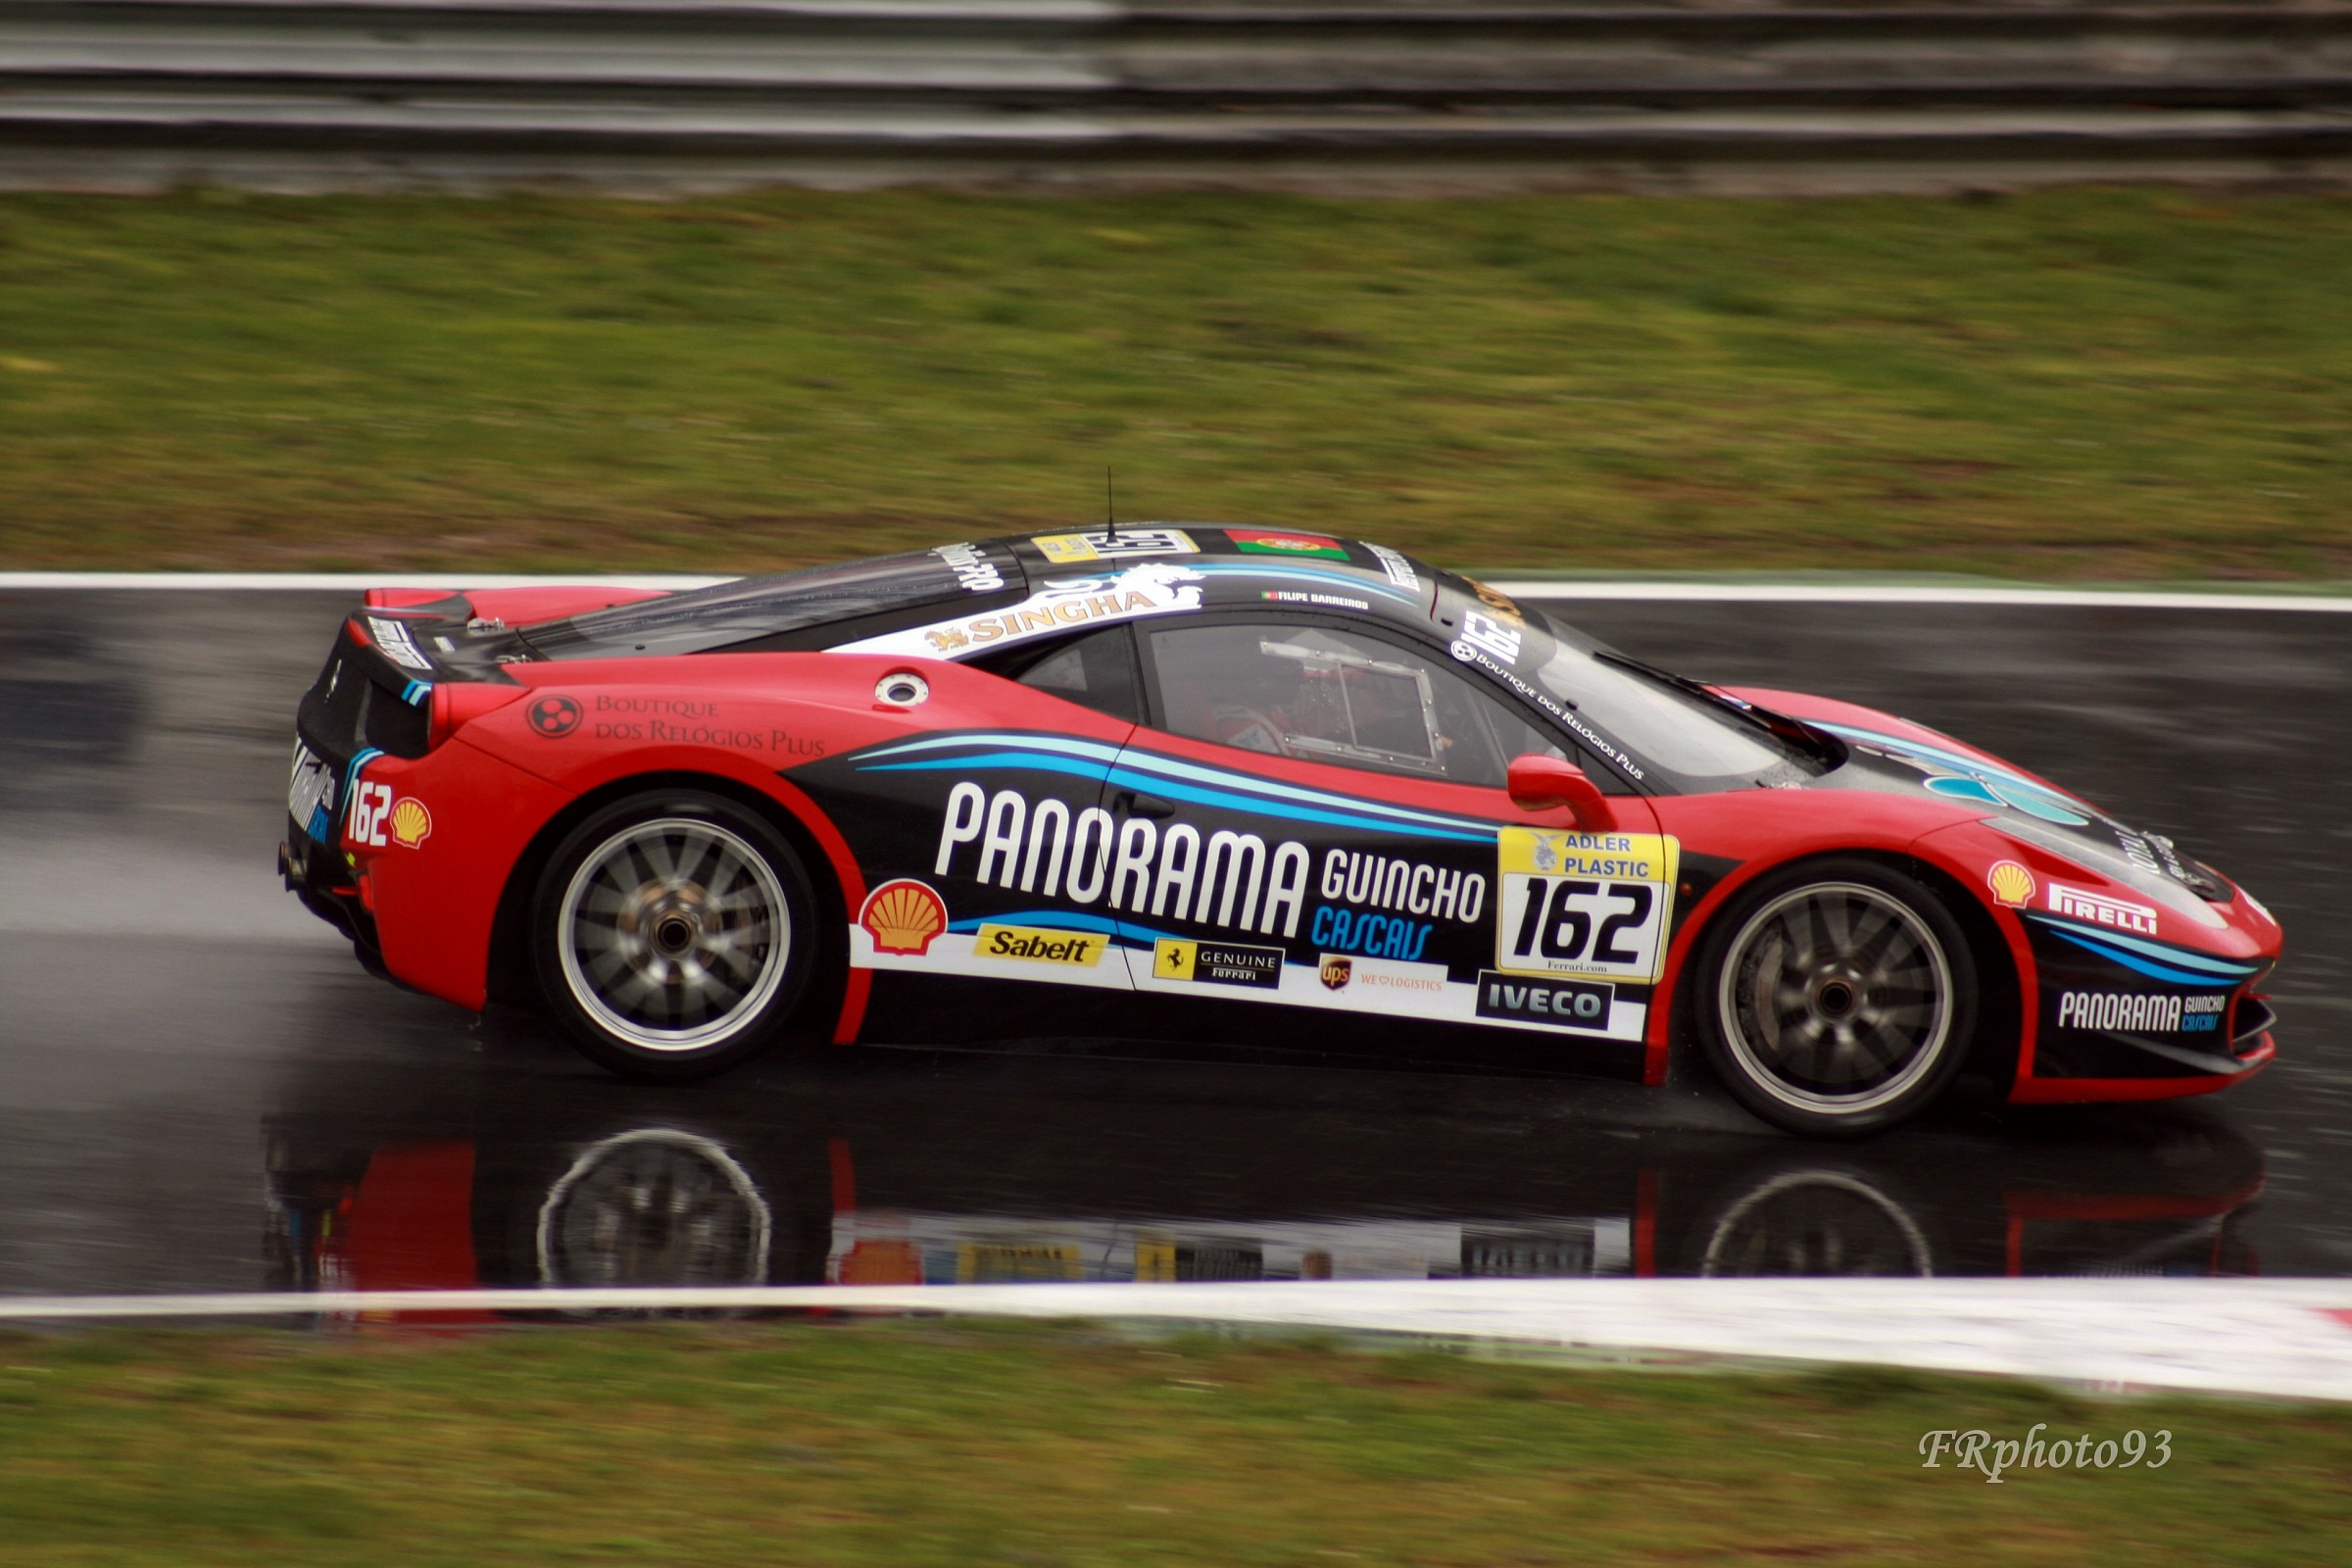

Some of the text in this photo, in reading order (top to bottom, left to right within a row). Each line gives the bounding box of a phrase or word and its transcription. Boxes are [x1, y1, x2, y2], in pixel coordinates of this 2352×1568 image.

[968, 591, 1156, 642] SINGHA
[1278, 591, 1369, 610] FILIPE BARREIROS
[1476, 654, 1537, 697] BOUTIQUE
[596, 695, 719, 720] BOUTIQUE
[348, 778, 392, 847] 162
[934, 781, 1486, 938] PANORAMA GUINCHO
[1565, 834, 1631, 853] ADLER
[1564, 857, 1649, 878] PLASTIC
[1513, 877, 1653, 965] 162
[2048, 882, 2157, 935] PIRELLI
[989, 930, 1090, 962] Sabelt
[1310, 905, 1433, 961] CASCAIS
[1200, 951, 1276, 968] GENUINE
[1211, 966, 1256, 981] Ferrari
[1322, 964, 1350, 987] ups
[1547, 960, 1608, 973] Ferrari.com
[1360, 973, 1443, 992] WE LOGISTICS
[1488, 983, 1602, 1018] IVECO
[2058, 991, 2226, 1032] PANORAMA GUINCHO
